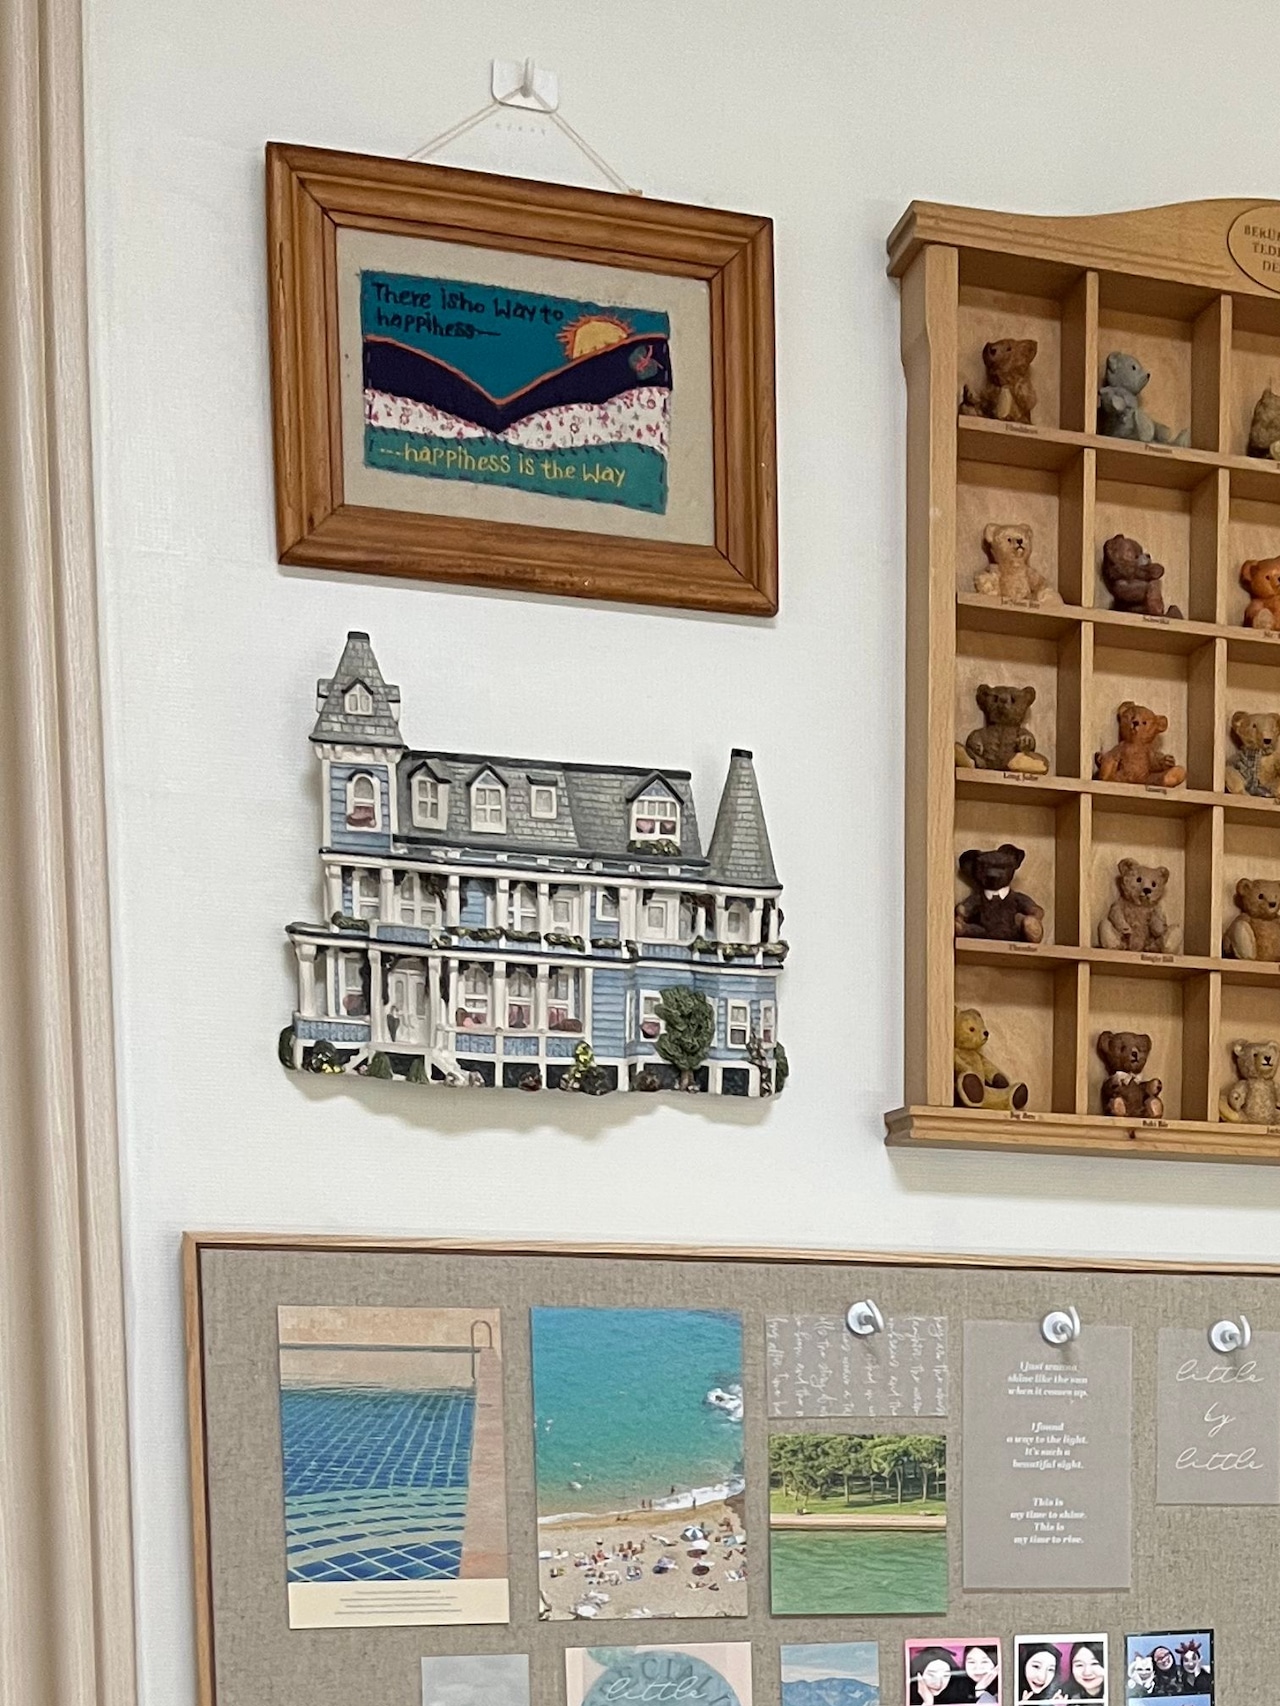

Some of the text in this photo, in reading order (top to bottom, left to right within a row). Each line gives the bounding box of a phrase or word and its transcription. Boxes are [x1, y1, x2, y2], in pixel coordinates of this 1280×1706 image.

[371, 282, 431, 309] There
[518, 454, 535, 476] is
[540, 457, 576, 479] the
[1175, 1359, 1265, 1383] little
[1007, 1373, 1034, 1383] shine
[1035, 1373, 1053, 1383] like
[1054, 1373, 1069, 1383] the
[1008, 1386, 1034, 1396] when
[1035, 1386, 1042, 1396] it
[1204, 1402, 1236, 1438] by
[1034, 1421, 1064, 1433] found
[1014, 1436, 1034, 1447] way
[1035, 1435, 1045, 1444] to
[1046, 1434, 1062, 1444] the
[1041, 1446, 1063, 1456] such
[1012, 1459, 1056, 1471] beautiful
[1175, 1447, 1264, 1471] little
[1033, 1497, 1064, 1507] This is
[1010, 1511, 1024, 1520] my
[1026, 1510, 1047, 1519] time
[1048, 1511, 1058, 1519] to
[1033, 1522, 1065, 1531] This is
[1014, 1537, 1028, 1545] my
[1029, 1535, 1051, 1544] time
[1051, 1536, 1061, 1544] to
[606, 1676, 708, 1701] little
